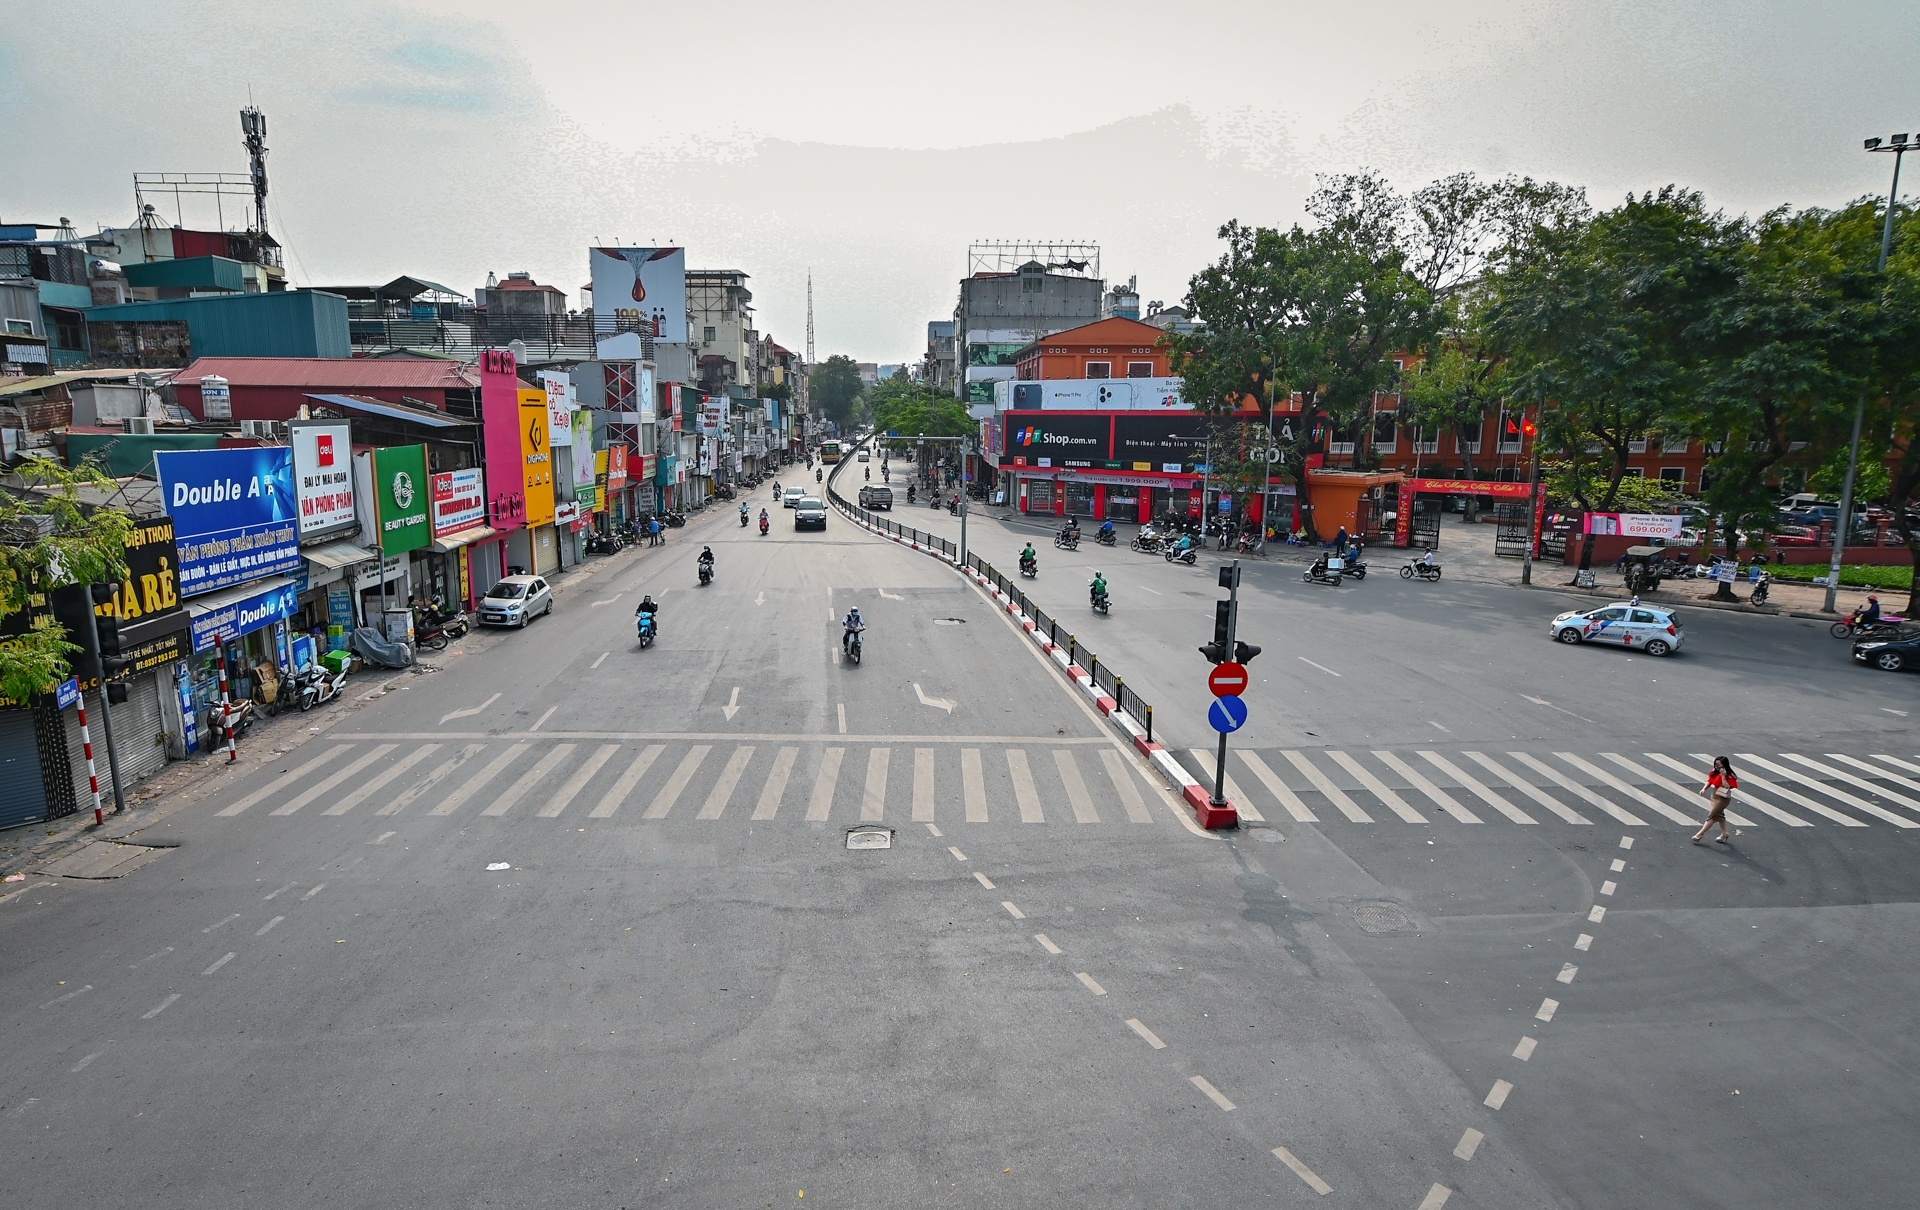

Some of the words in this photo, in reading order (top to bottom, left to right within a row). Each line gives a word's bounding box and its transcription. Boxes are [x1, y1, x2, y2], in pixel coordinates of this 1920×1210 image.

[320, 445, 333, 455] deli
[1161, 440, 1172, 448] Máy
[1174, 439, 1188, 447] tính
[173, 478, 241, 507] Double
[247, 475, 260, 499] A
[304, 475, 314, 489] ĐẠI
[314, 472, 321, 487] LÝ
[322, 473, 333, 486] MAI
[301, 495, 315, 517] VĂN
[315, 491, 335, 515] PHÒNG
[335, 484, 353, 511] PHẨM
[1190, 496, 1201, 505] 269
[385, 517, 405, 532] BEAUTY
[405, 513, 427, 527] GARDEN
[147, 523, 173, 544] THOẠI
[177, 542, 199, 563] VĂN
[199, 538, 231, 560] PHÒNG
[230, 528, 255, 554] PHẨM
[139, 555, 177, 614] RẺ
[240, 600, 275, 627] Double
[278, 595, 286, 612] A
